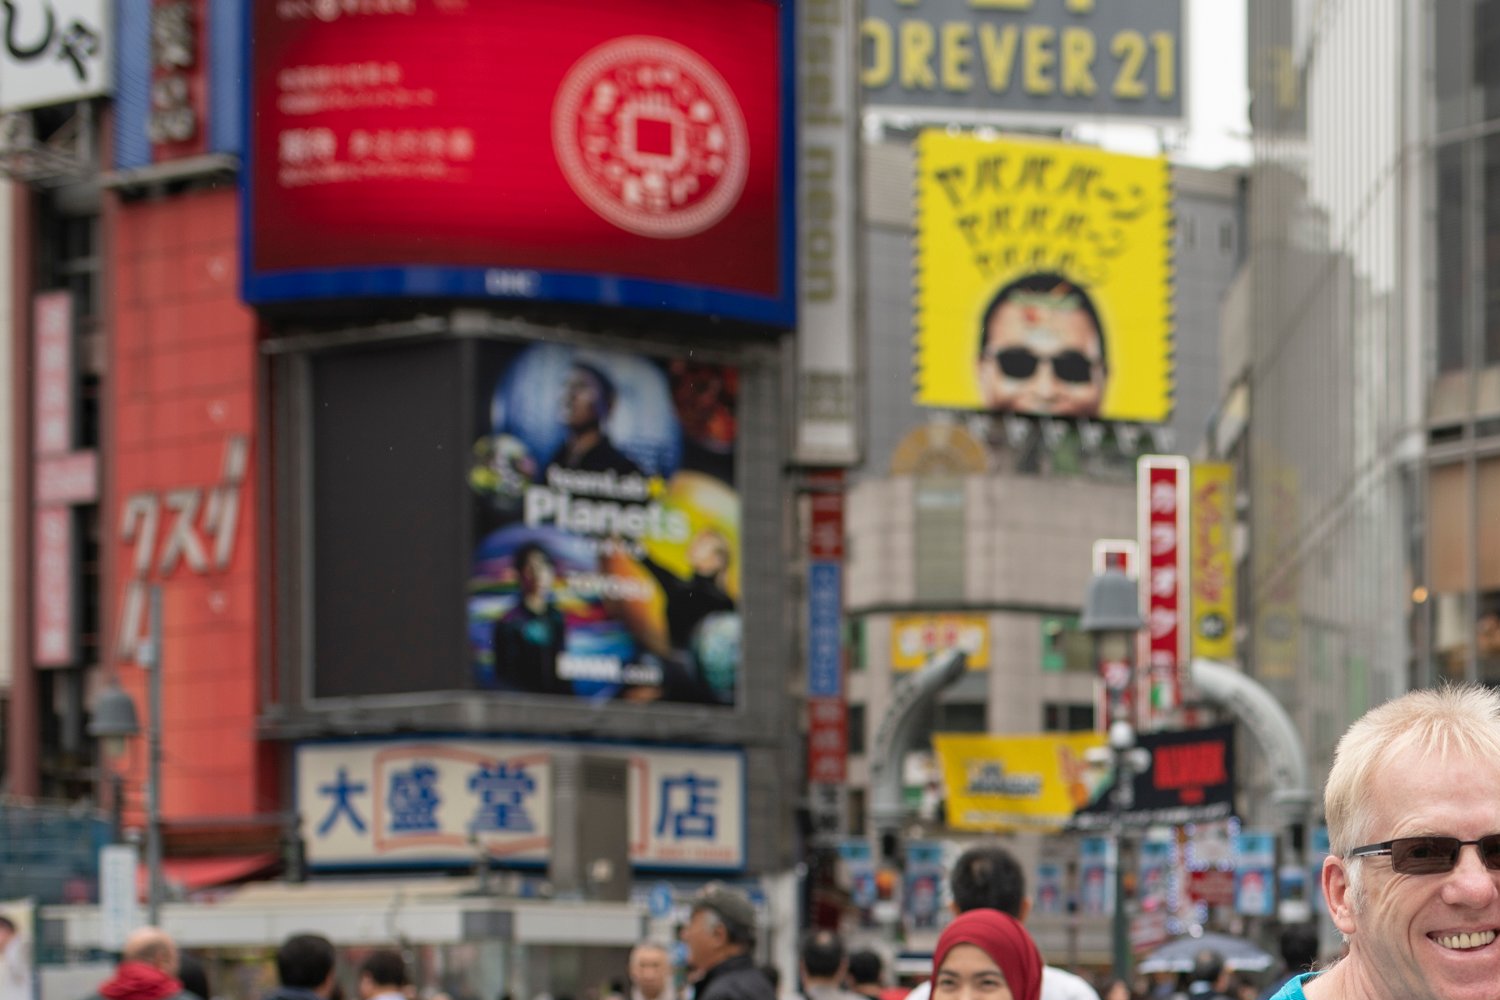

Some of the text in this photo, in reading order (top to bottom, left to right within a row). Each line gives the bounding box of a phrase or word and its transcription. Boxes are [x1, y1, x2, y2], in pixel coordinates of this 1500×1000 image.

[1110, 30, 1176, 99] 21
[524, 486, 691, 544] Planets
[316, 759, 720, 842] 大盛堂店
